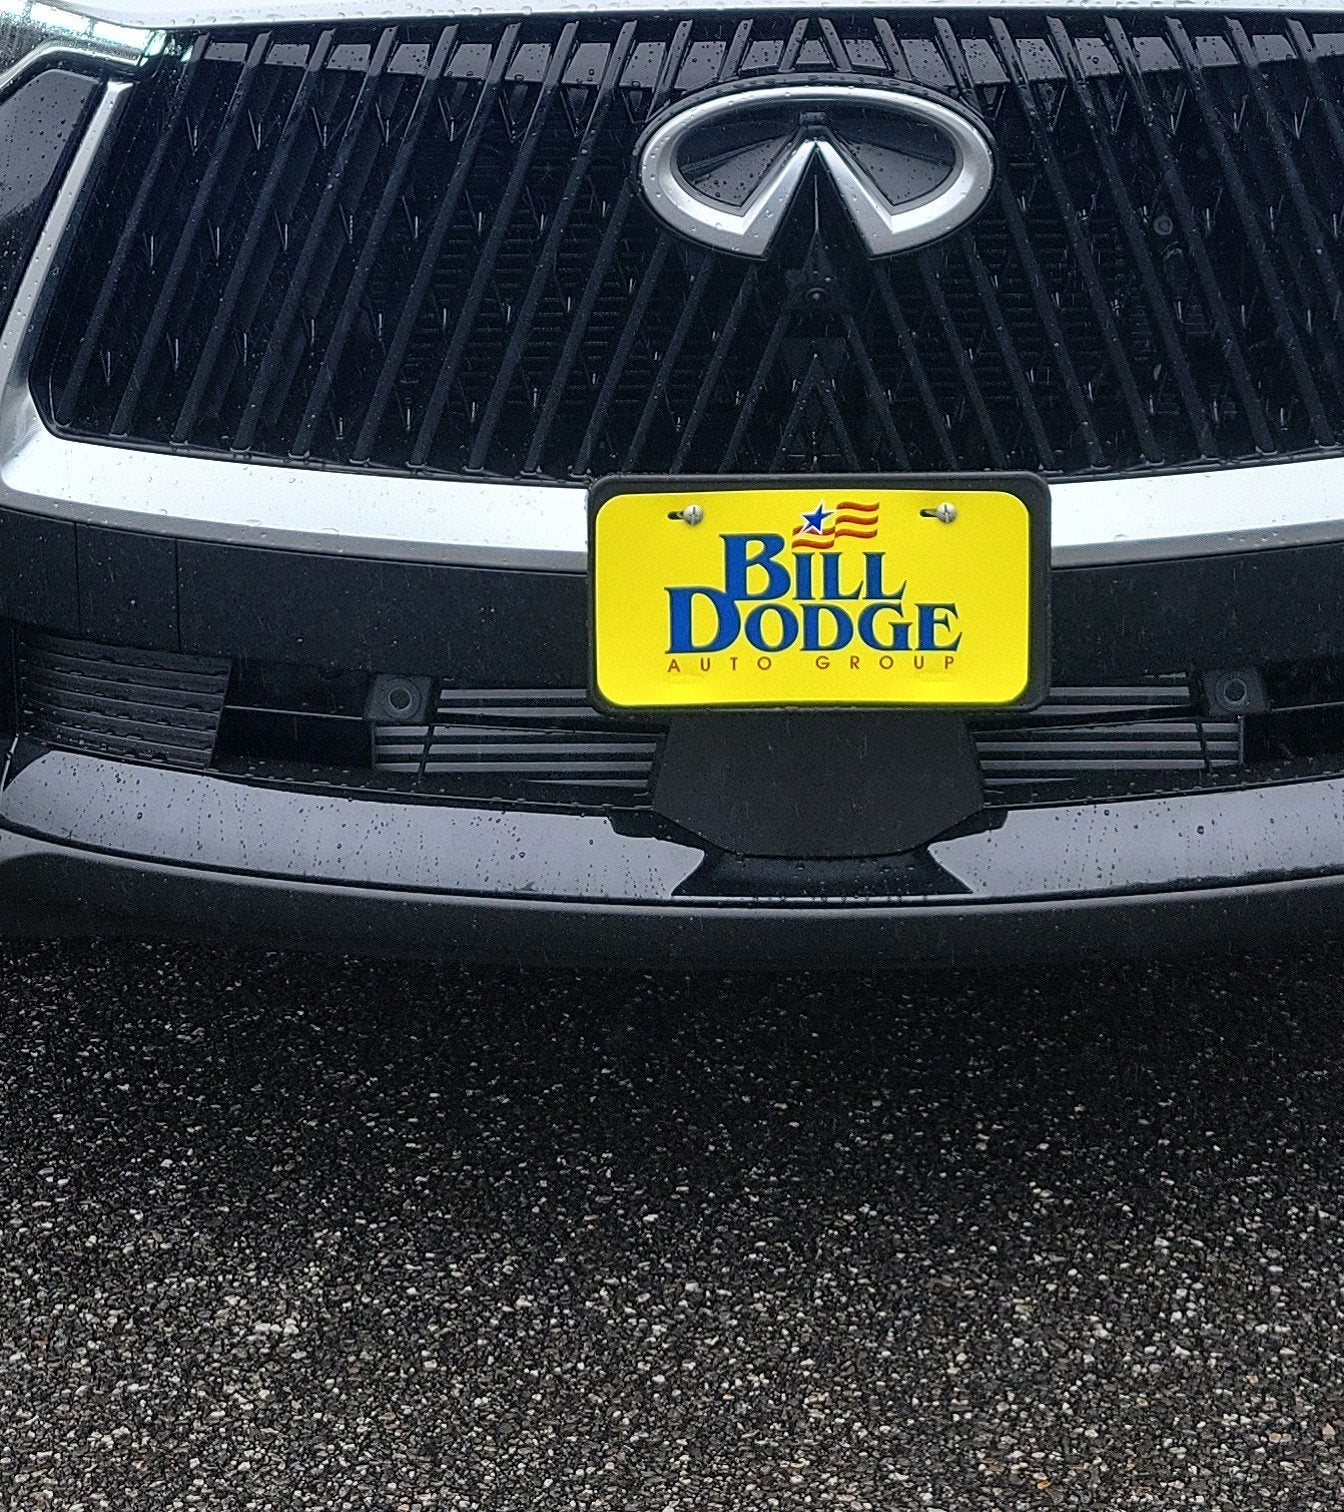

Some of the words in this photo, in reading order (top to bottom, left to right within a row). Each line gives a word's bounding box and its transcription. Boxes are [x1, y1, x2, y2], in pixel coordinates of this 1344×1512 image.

[719, 533, 907, 601] BILL
[664, 586, 963, 655] DODGE
[667, 655, 772, 674] AUTO
[815, 654, 957, 671] GROUP
